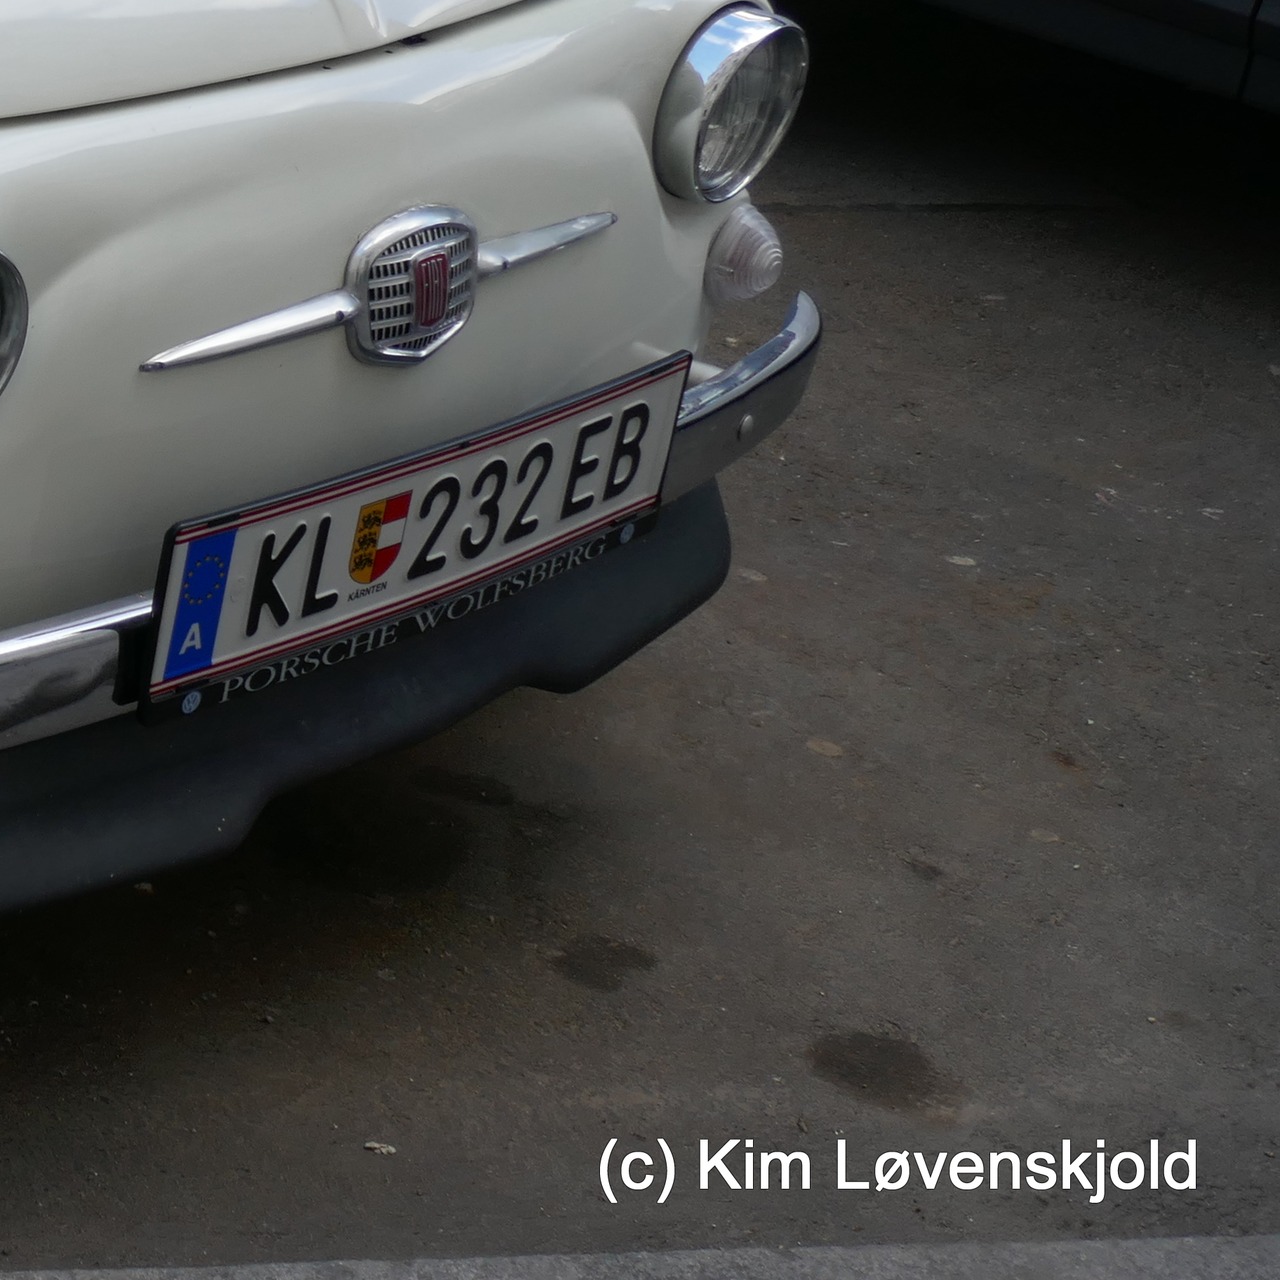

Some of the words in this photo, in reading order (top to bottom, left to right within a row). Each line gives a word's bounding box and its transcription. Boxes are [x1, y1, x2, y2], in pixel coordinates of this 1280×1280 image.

[245, 515, 339, 638] KL
[406, 438, 554, 580] 232
[560, 402, 650, 521] EB
[178, 622, 203, 655] A
[217, 620, 401, 704] PORSCHE
[414, 536, 607, 635] WOLFSBERG
[347, 581, 388, 603] KÄRNTEN
